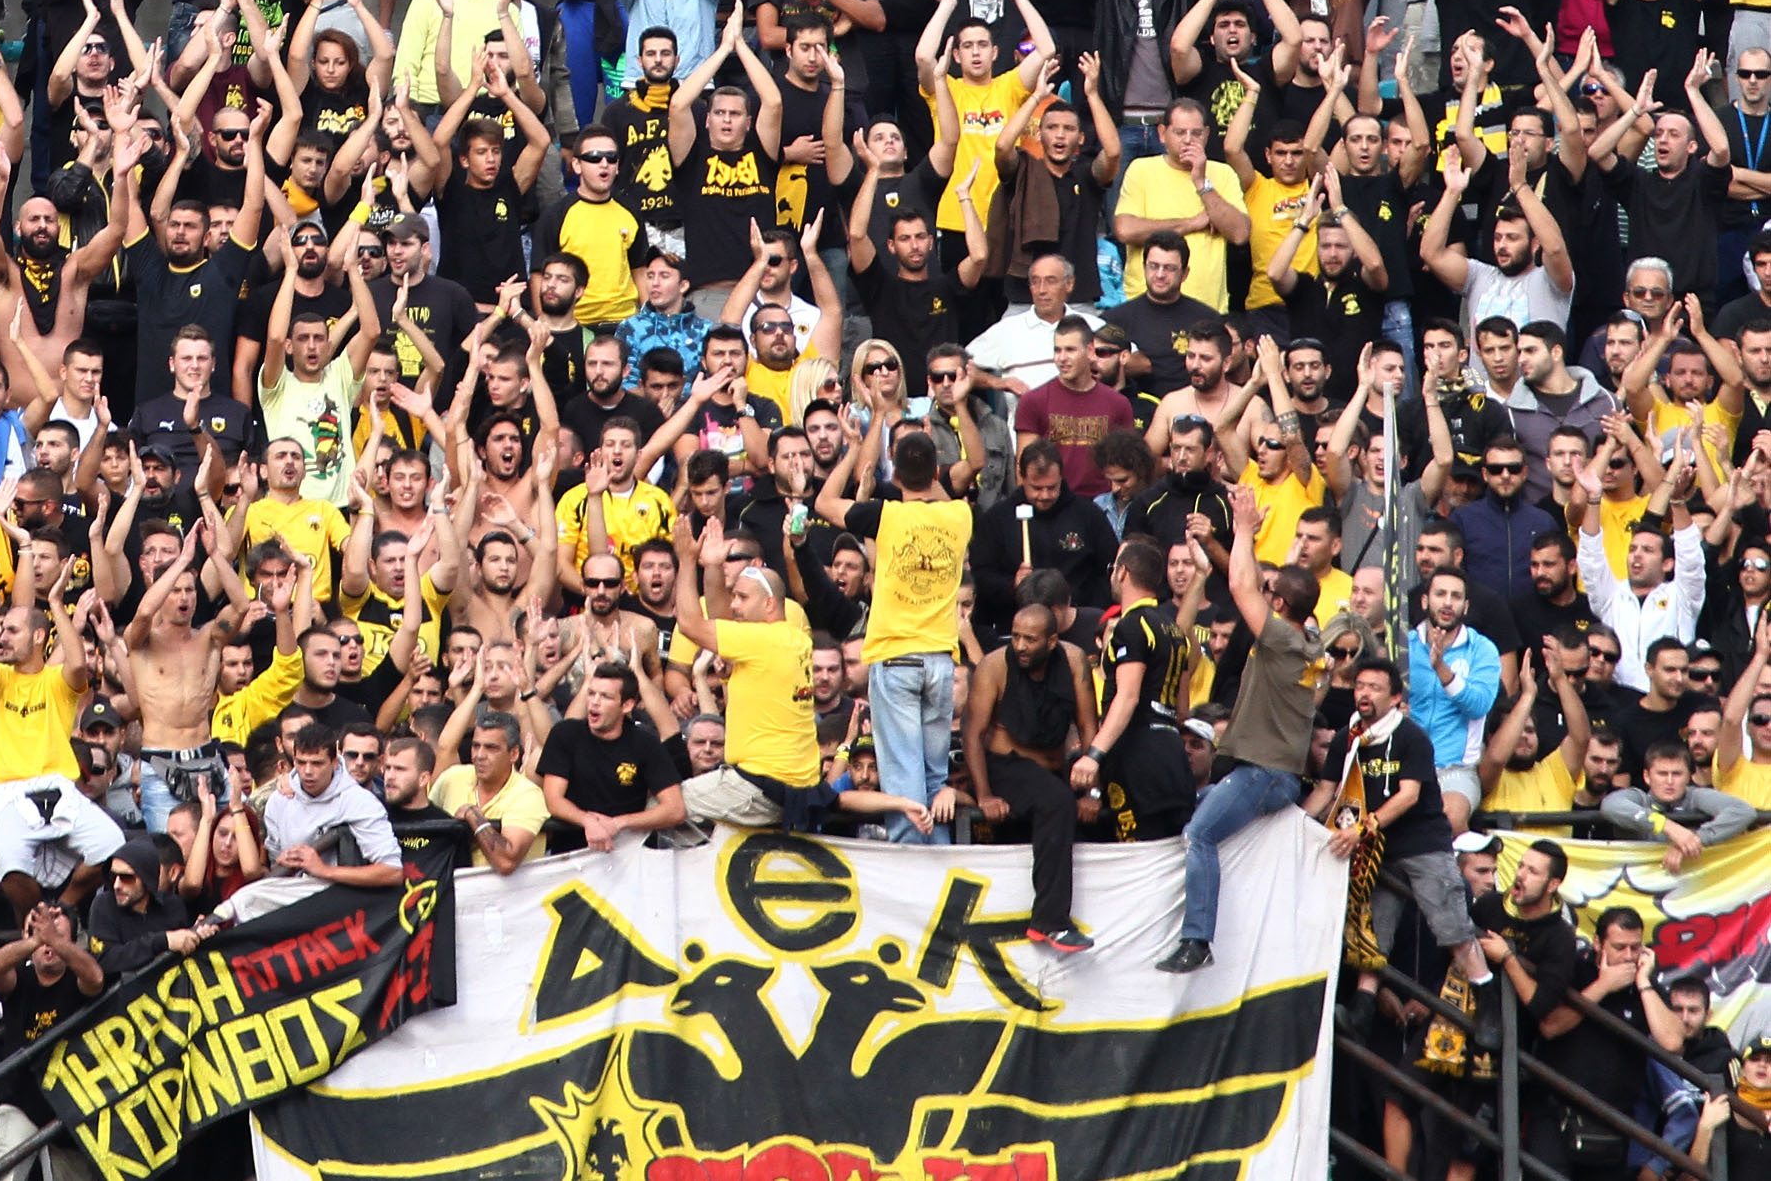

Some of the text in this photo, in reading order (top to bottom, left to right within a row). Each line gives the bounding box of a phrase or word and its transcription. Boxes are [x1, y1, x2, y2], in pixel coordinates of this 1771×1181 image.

[640, 196, 673, 211] 1924
[391, 306, 432, 324] LRTAD
[231, 908, 381, 999] ATTACK
[41, 950, 245, 1117] THRASH
